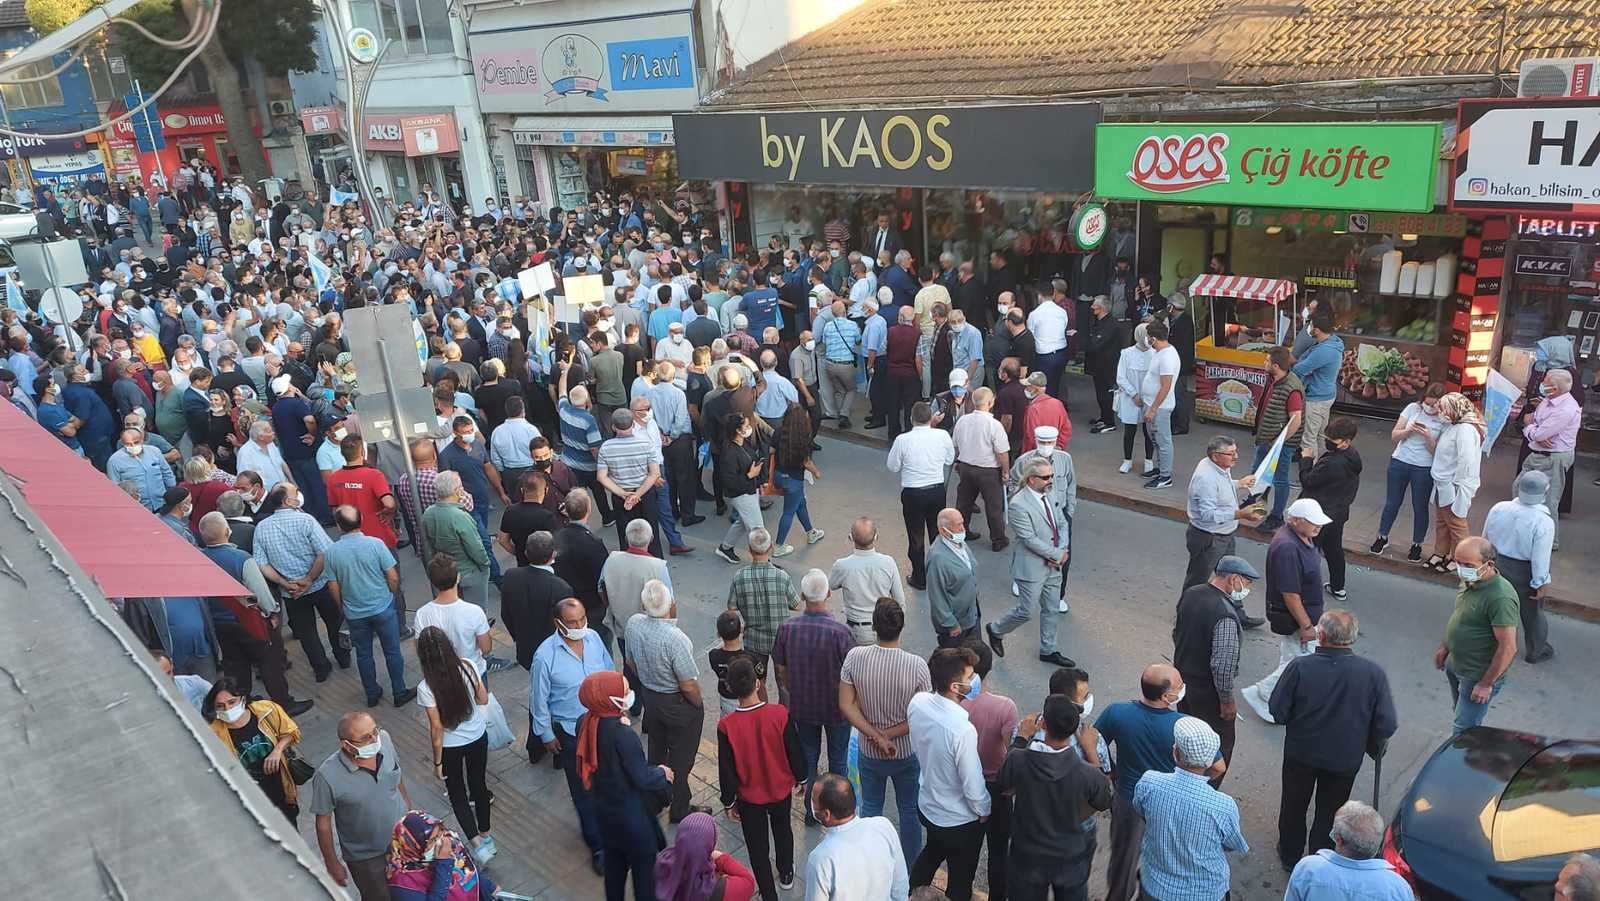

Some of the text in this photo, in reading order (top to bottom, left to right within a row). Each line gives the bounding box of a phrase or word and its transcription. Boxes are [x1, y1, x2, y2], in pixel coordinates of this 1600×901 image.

[480, 58, 538, 92] Pembe
[621, 51, 681, 81] Mavi
[369, 124, 402, 140] AKB
[760, 114, 953, 181] by KAOS
[1240, 147, 1291, 186] Çiğ
[1299, 145, 1391, 187] köfte
[1518, 214, 1600, 237] TABLET
[1521, 260, 1567, 272] K.V.K.
